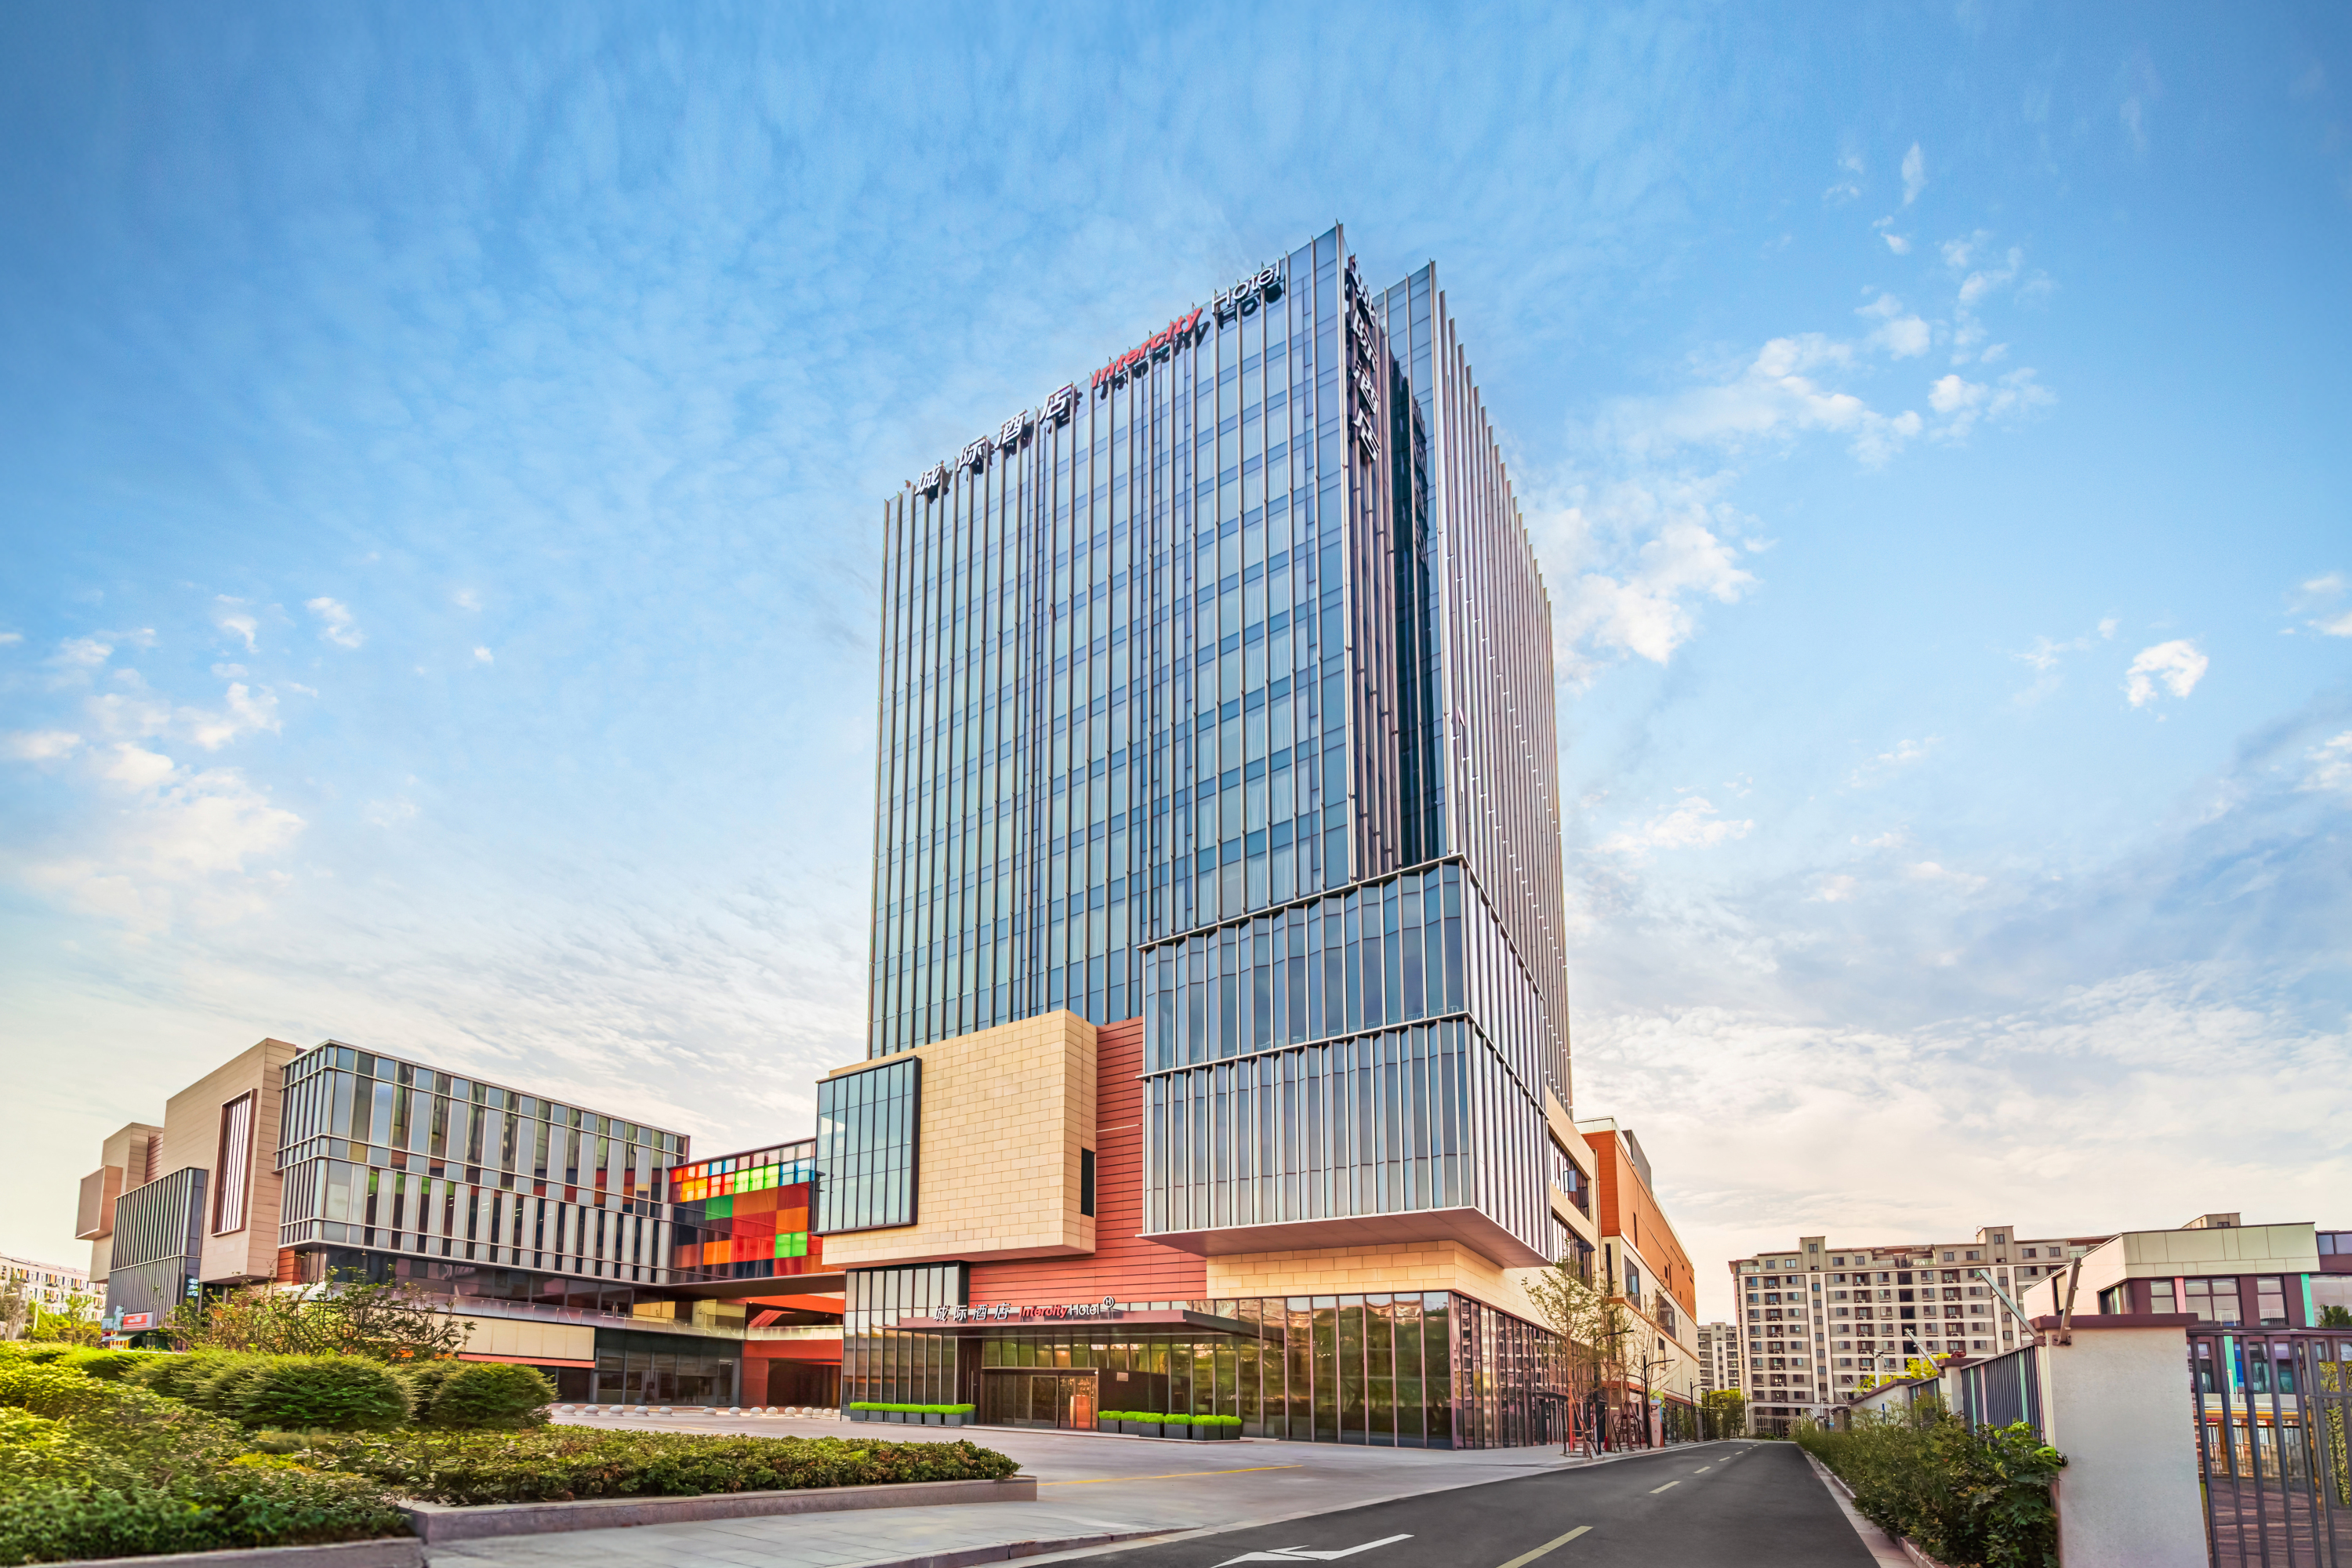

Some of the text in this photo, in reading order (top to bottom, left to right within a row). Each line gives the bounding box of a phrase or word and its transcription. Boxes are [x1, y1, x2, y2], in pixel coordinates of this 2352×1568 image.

[915, 257, 1280, 495] 城际酒店 Intercity Hotel
[1349, 260, 1380, 461] 城际酒店
[933, 1302, 1010, 1321] 城际酒店
[1650, 1405, 1658, 1414] P
